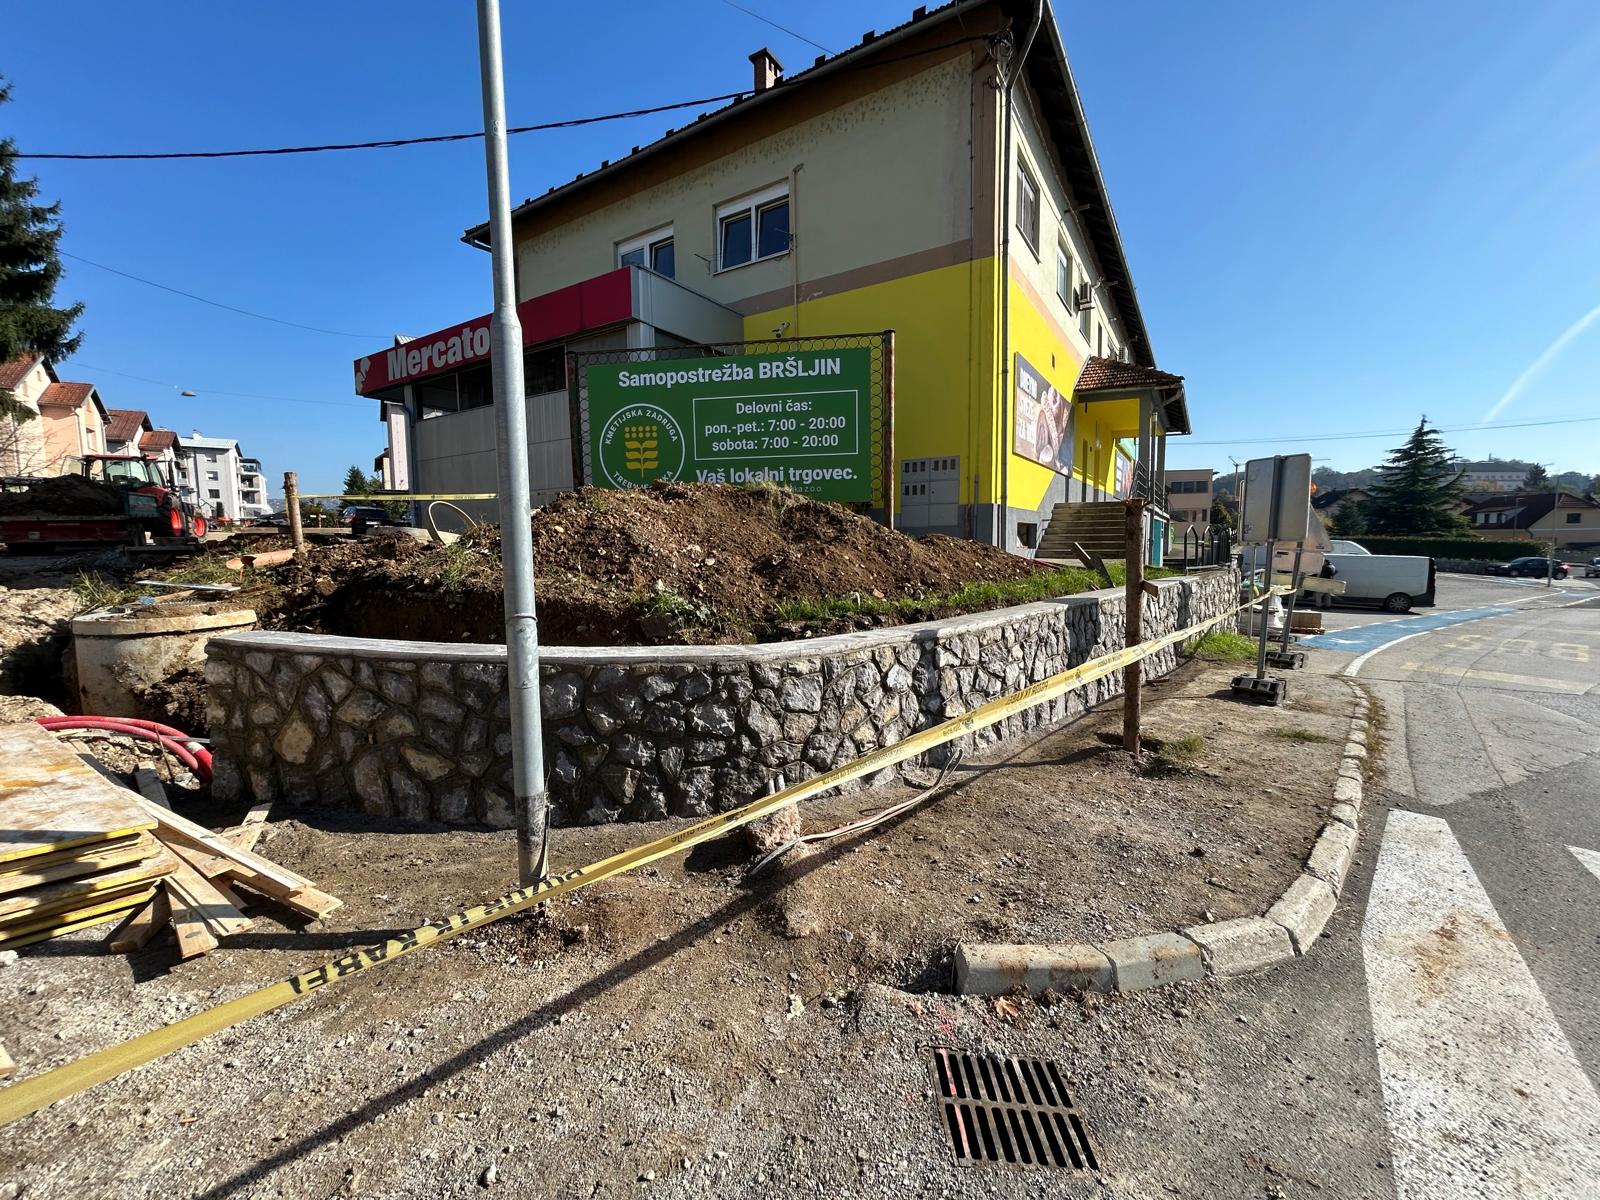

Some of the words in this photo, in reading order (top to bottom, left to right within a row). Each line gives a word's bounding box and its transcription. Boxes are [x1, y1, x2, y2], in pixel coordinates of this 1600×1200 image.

[387, 326, 491, 382] Mercato
[618, 364, 753, 389] Samopostrežba
[758, 356, 841, 379] BRŠLJIN
[736, 400, 782, 415] Delovni
[785, 399, 812, 412] čas:
[605, 409, 644, 445] KMETIJSKA
[645, 409, 678, 443] ZADRUGA
[704, 420, 765, 437] pon.-pet.:
[767, 418, 796, 431] 7:00
[808, 416, 846, 430] 20:00
[712, 438, 758, 452] sobota:
[761, 436, 790, 449] 7:00
[801, 434, 839, 448] 20:00
[695, 467, 726, 484] Vaš
[729, 466, 784, 483] lokalni
[788, 466, 858, 484] trgovec.
